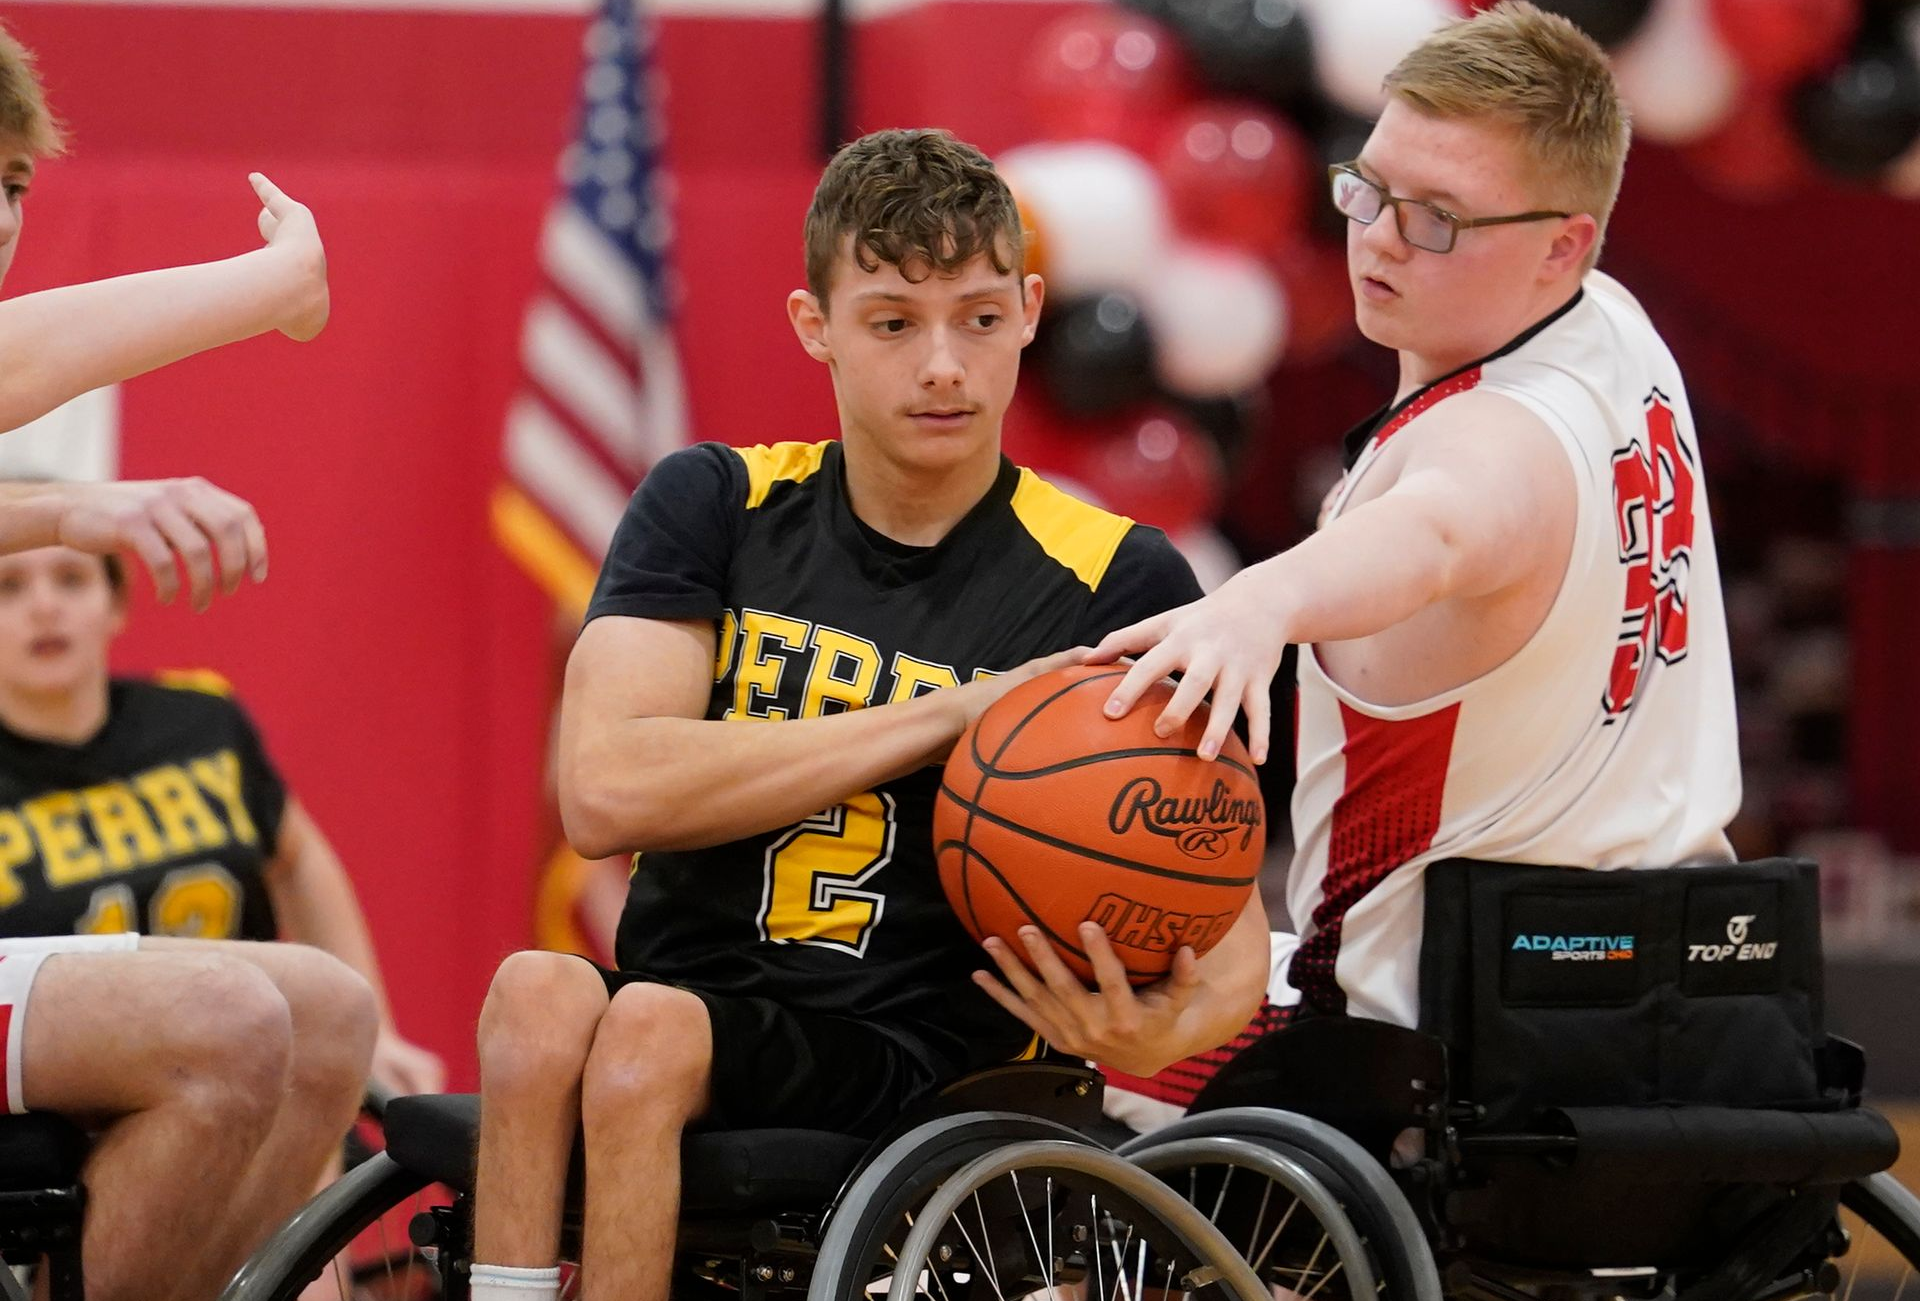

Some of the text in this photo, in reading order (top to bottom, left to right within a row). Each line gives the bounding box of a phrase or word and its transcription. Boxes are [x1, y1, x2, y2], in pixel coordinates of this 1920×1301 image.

[755, 791, 897, 960] 2
[1512, 935, 1635, 951] ADAPTIVE
[1687, 942, 1778, 962] TOP END
[1551, 950, 1605, 961] SPORTS
